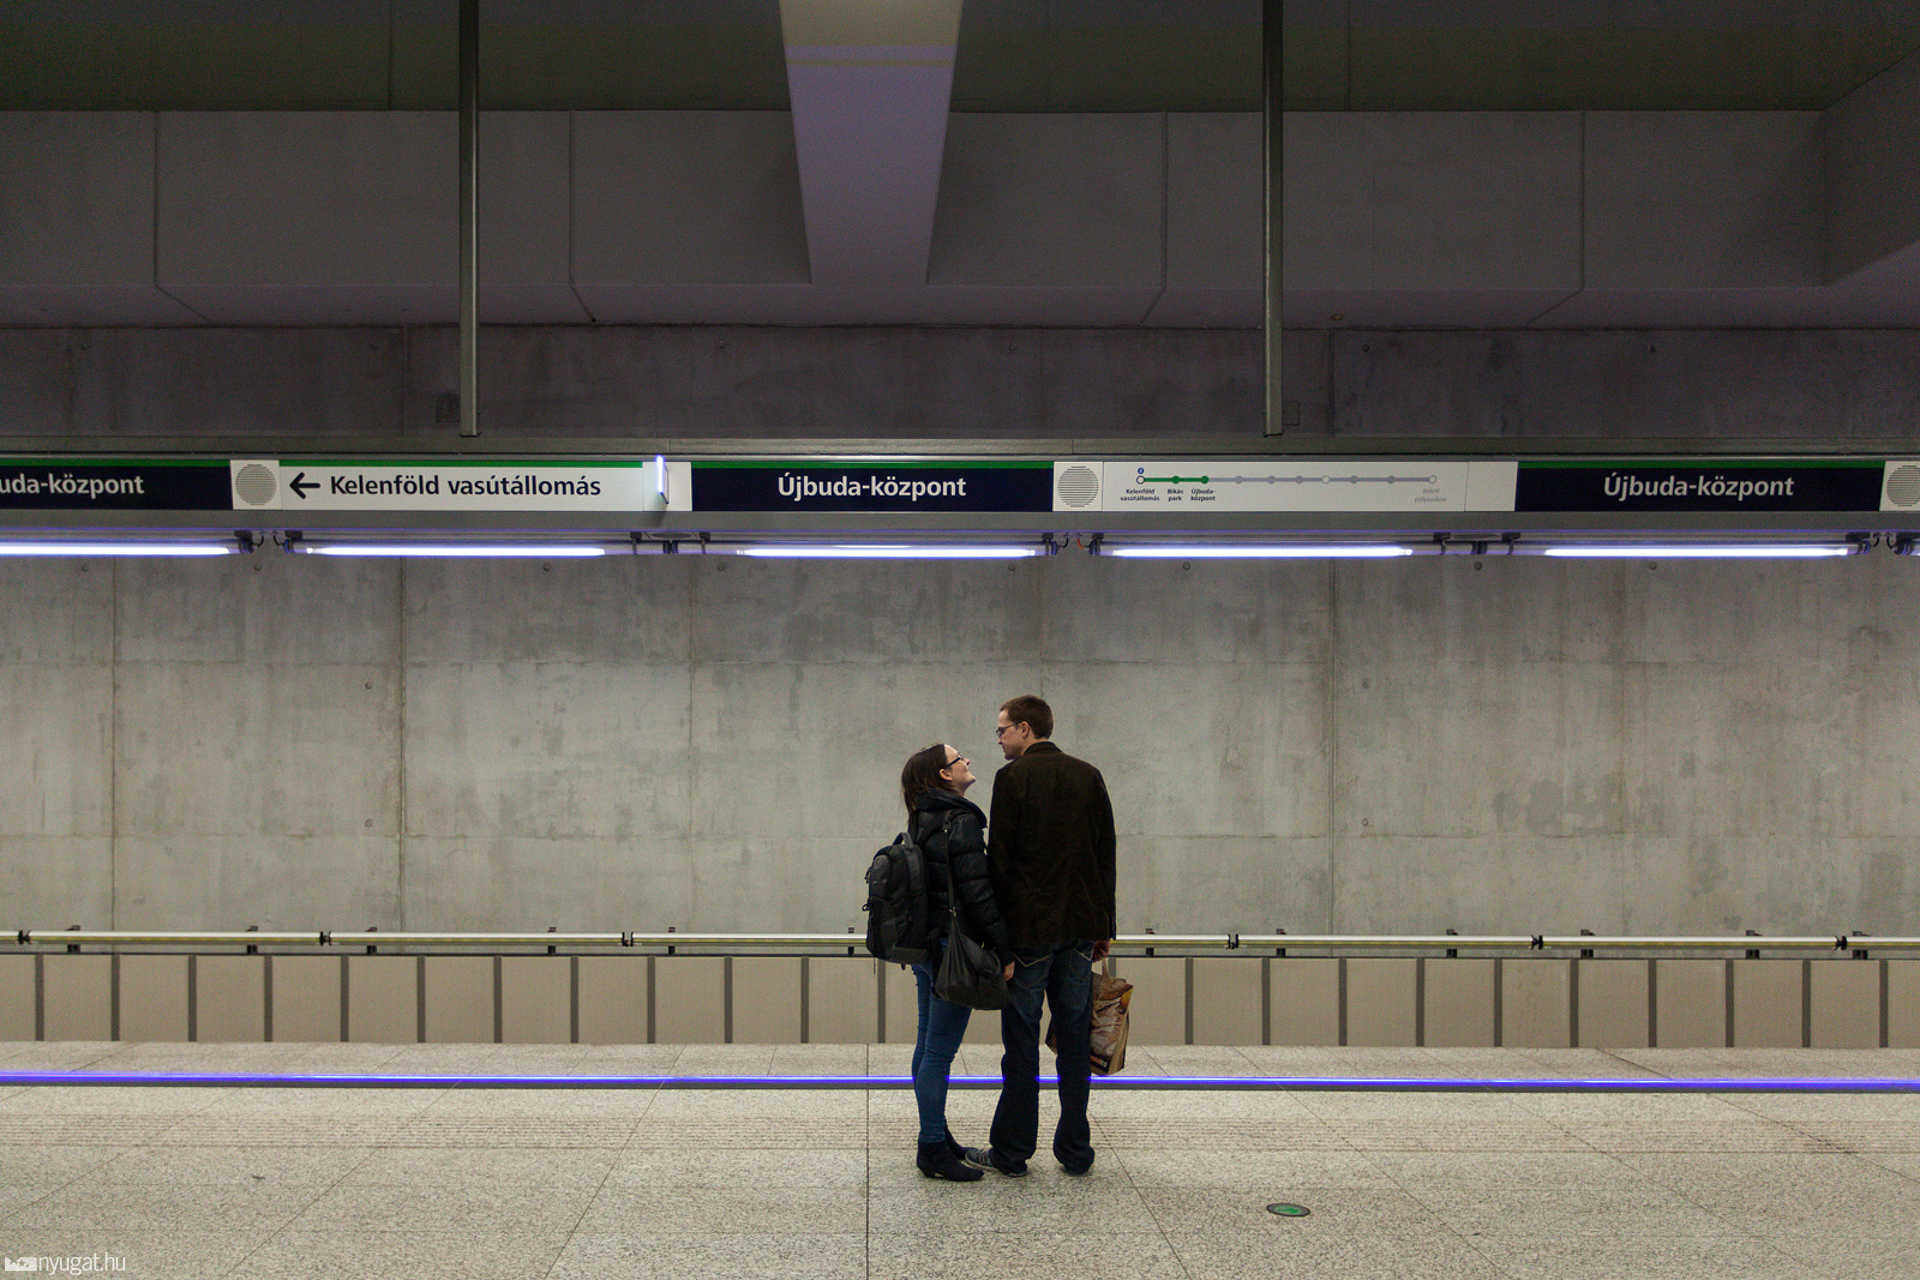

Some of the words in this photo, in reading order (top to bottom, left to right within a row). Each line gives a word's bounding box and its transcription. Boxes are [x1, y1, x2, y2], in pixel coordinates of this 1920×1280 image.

[331, 474, 439, 495] Kelenföld
[447, 474, 602, 496] vasútállomás
[778, 471, 967, 502] Újbuda-központ
[1604, 471, 1795, 502] Újbuda-központ
